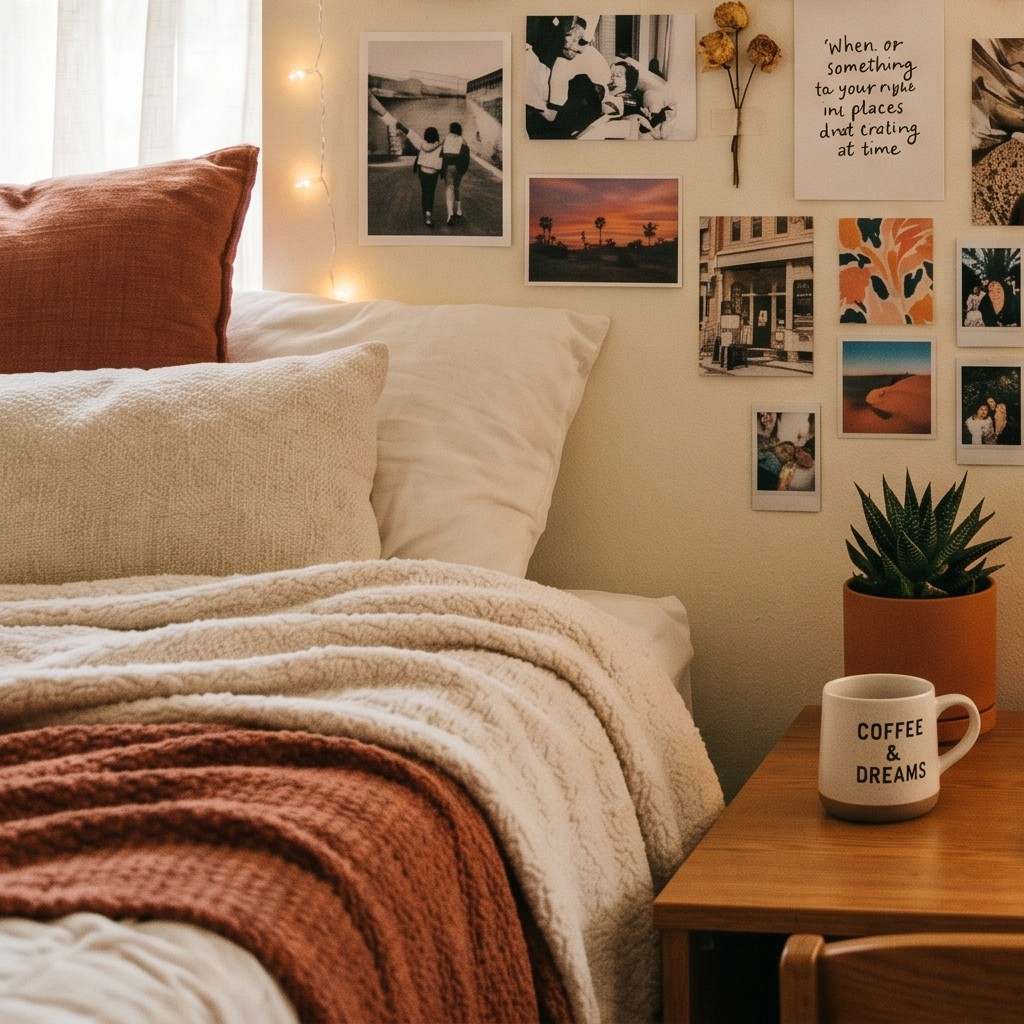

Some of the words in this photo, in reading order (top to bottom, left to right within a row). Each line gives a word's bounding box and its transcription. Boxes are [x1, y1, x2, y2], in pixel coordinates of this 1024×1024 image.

[883, 39, 904, 52] or
[827, 56, 918, 81] something
[839, 83, 877, 100] your
[851, 99, 904, 122] places
[837, 141, 855, 157] at
[861, 140, 902, 156] time
[857, 719, 923, 740] COFFEE
[886, 744, 900, 761] &
[856, 761, 926, 784] DREAMS
